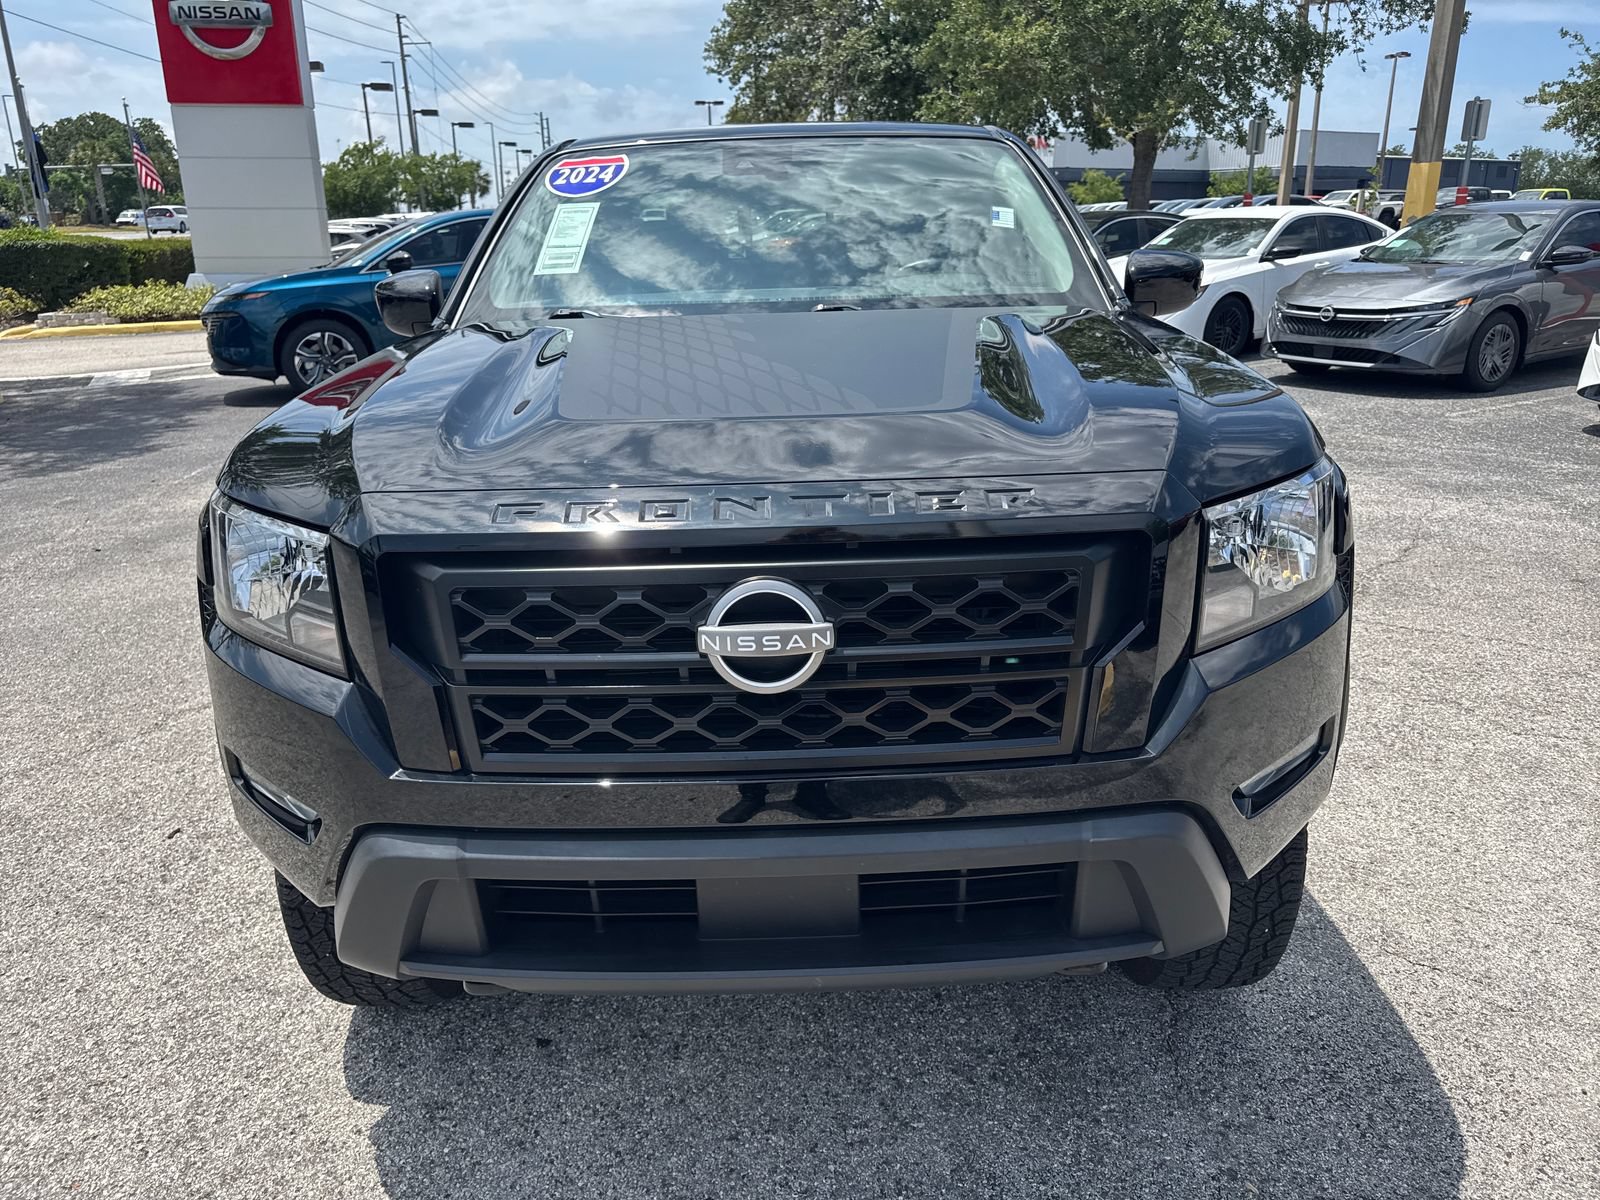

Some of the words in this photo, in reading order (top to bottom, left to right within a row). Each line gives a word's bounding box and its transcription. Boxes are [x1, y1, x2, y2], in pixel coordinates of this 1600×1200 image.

[177, 5, 261, 21] NISSAN
[553, 164, 616, 186] 2024
[488, 487, 1044, 525] FRONTIER
[701, 630, 831, 652] NISSAN
